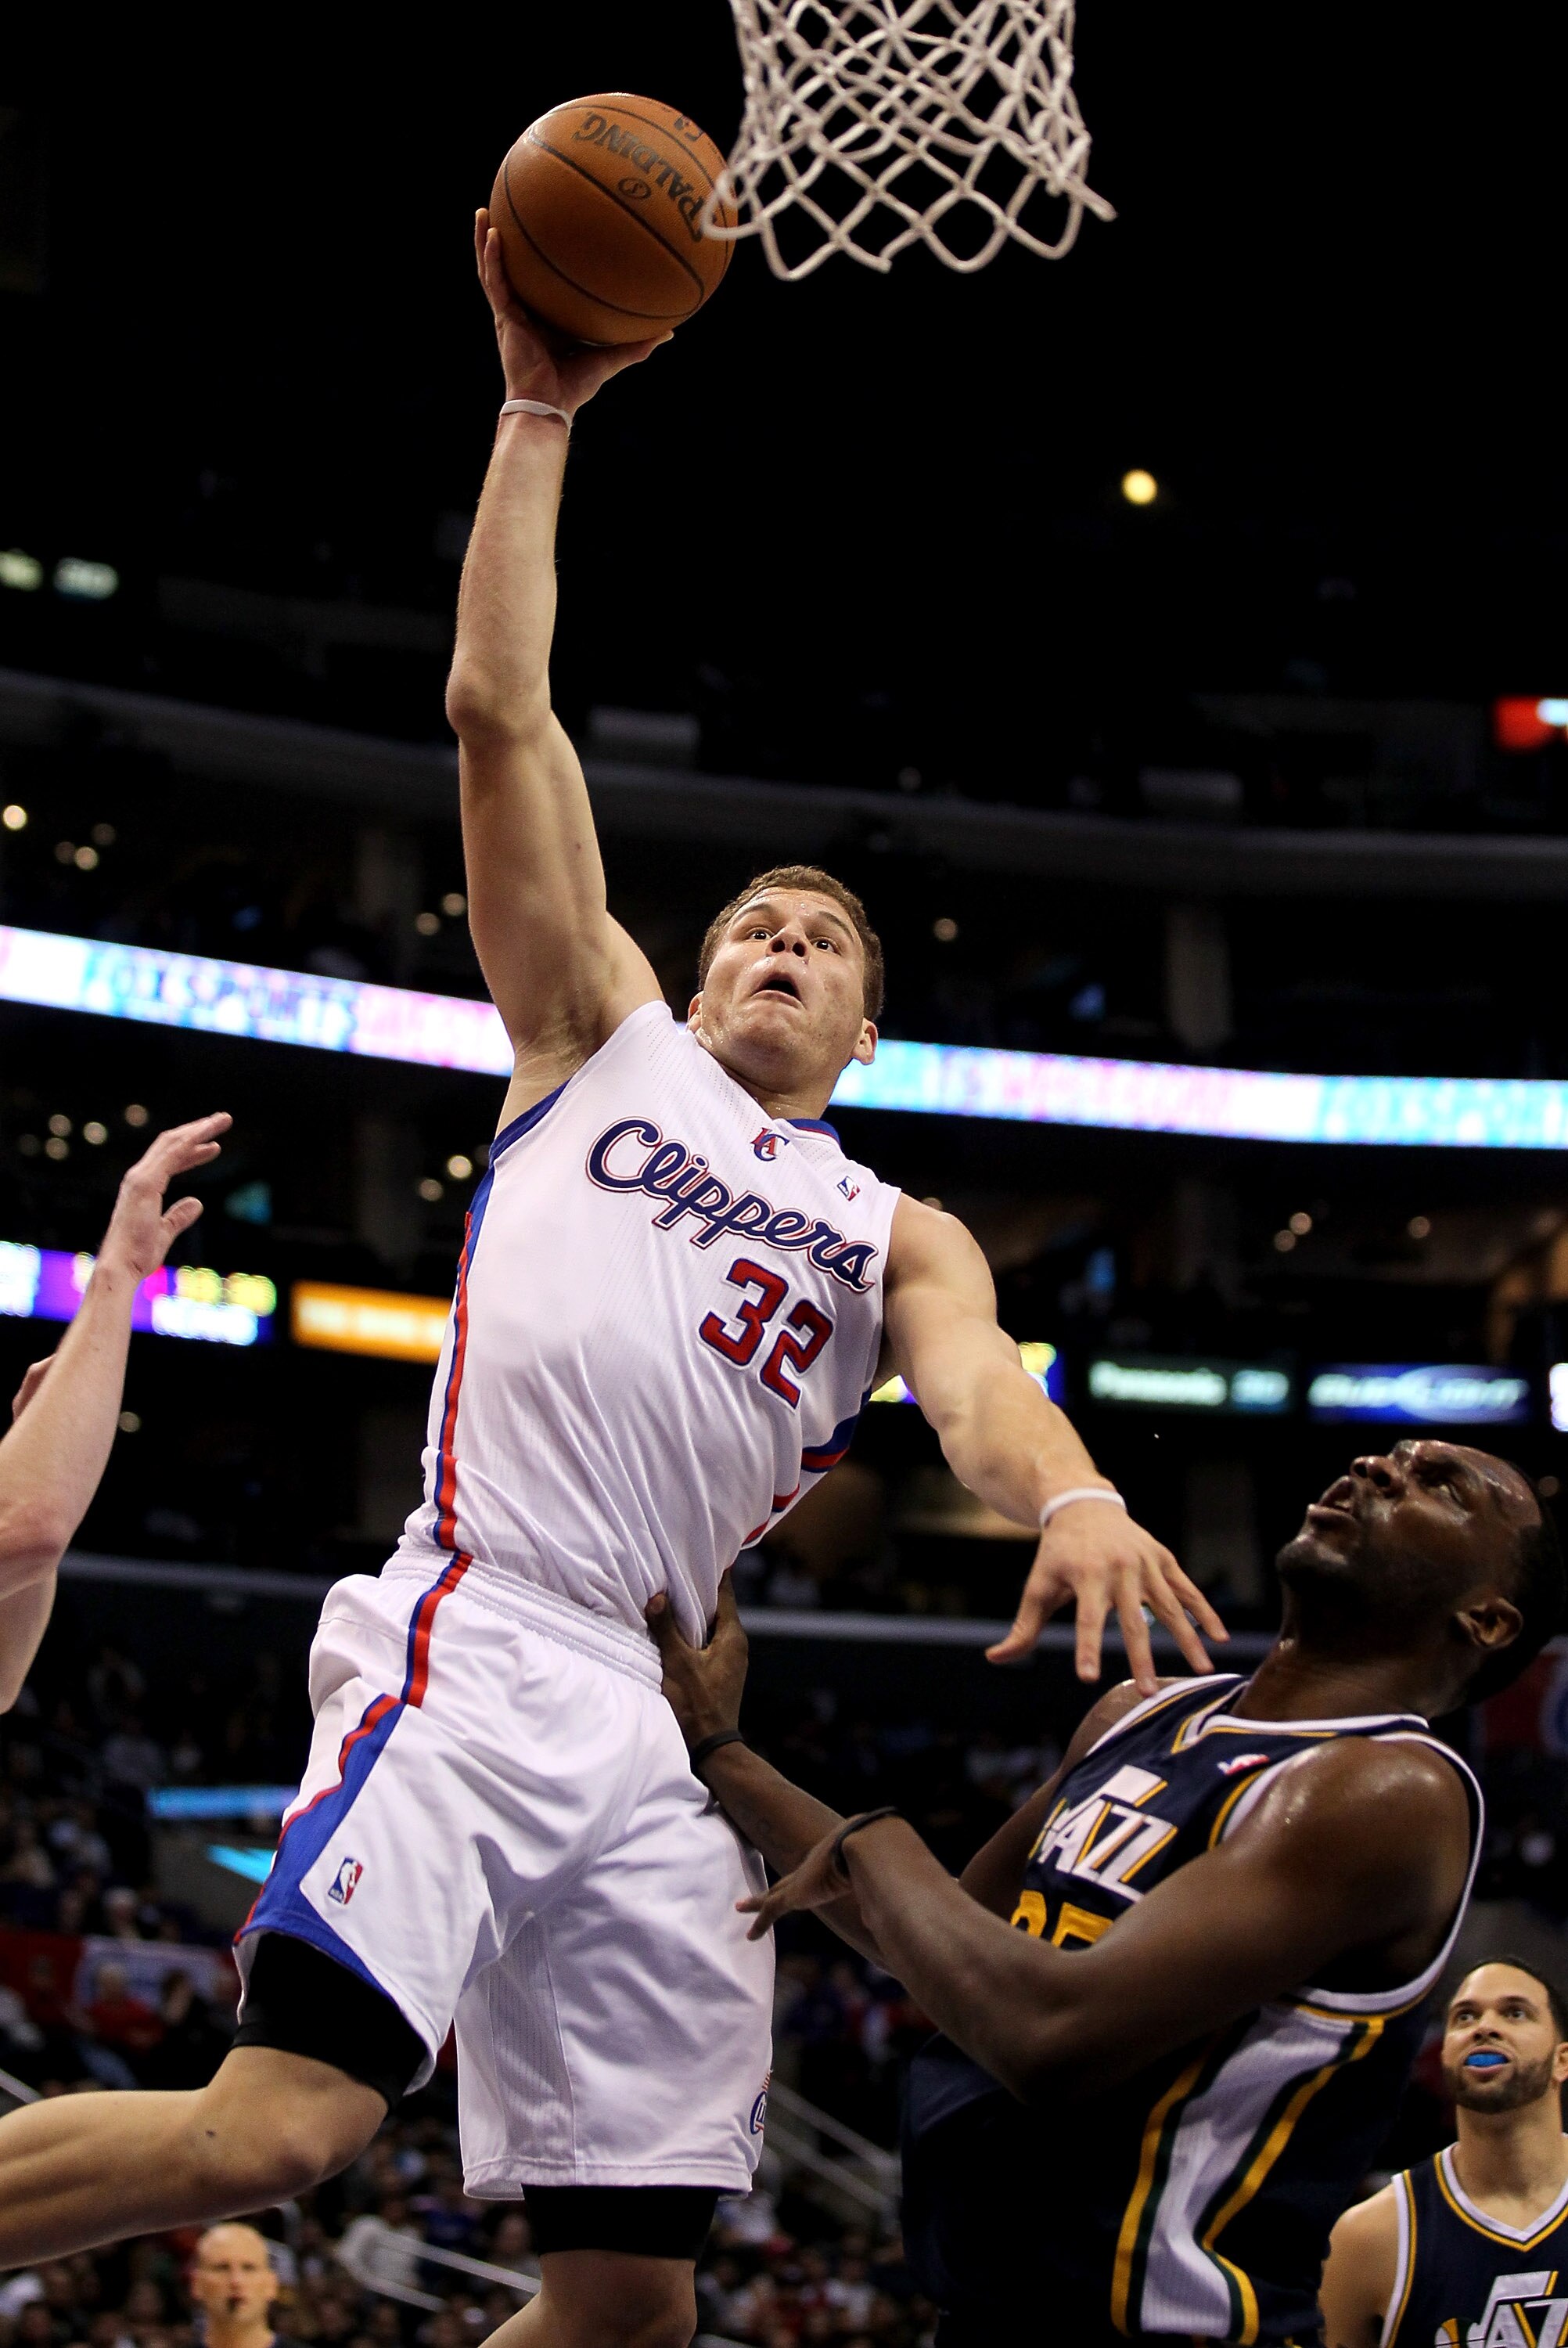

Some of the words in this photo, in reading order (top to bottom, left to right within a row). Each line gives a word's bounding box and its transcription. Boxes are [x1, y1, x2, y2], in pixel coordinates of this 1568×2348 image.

[586, 1116, 879, 1292] Clippers
[699, 1258, 834, 1409] 32
[1028, 1764, 1178, 1903] JAZZ
